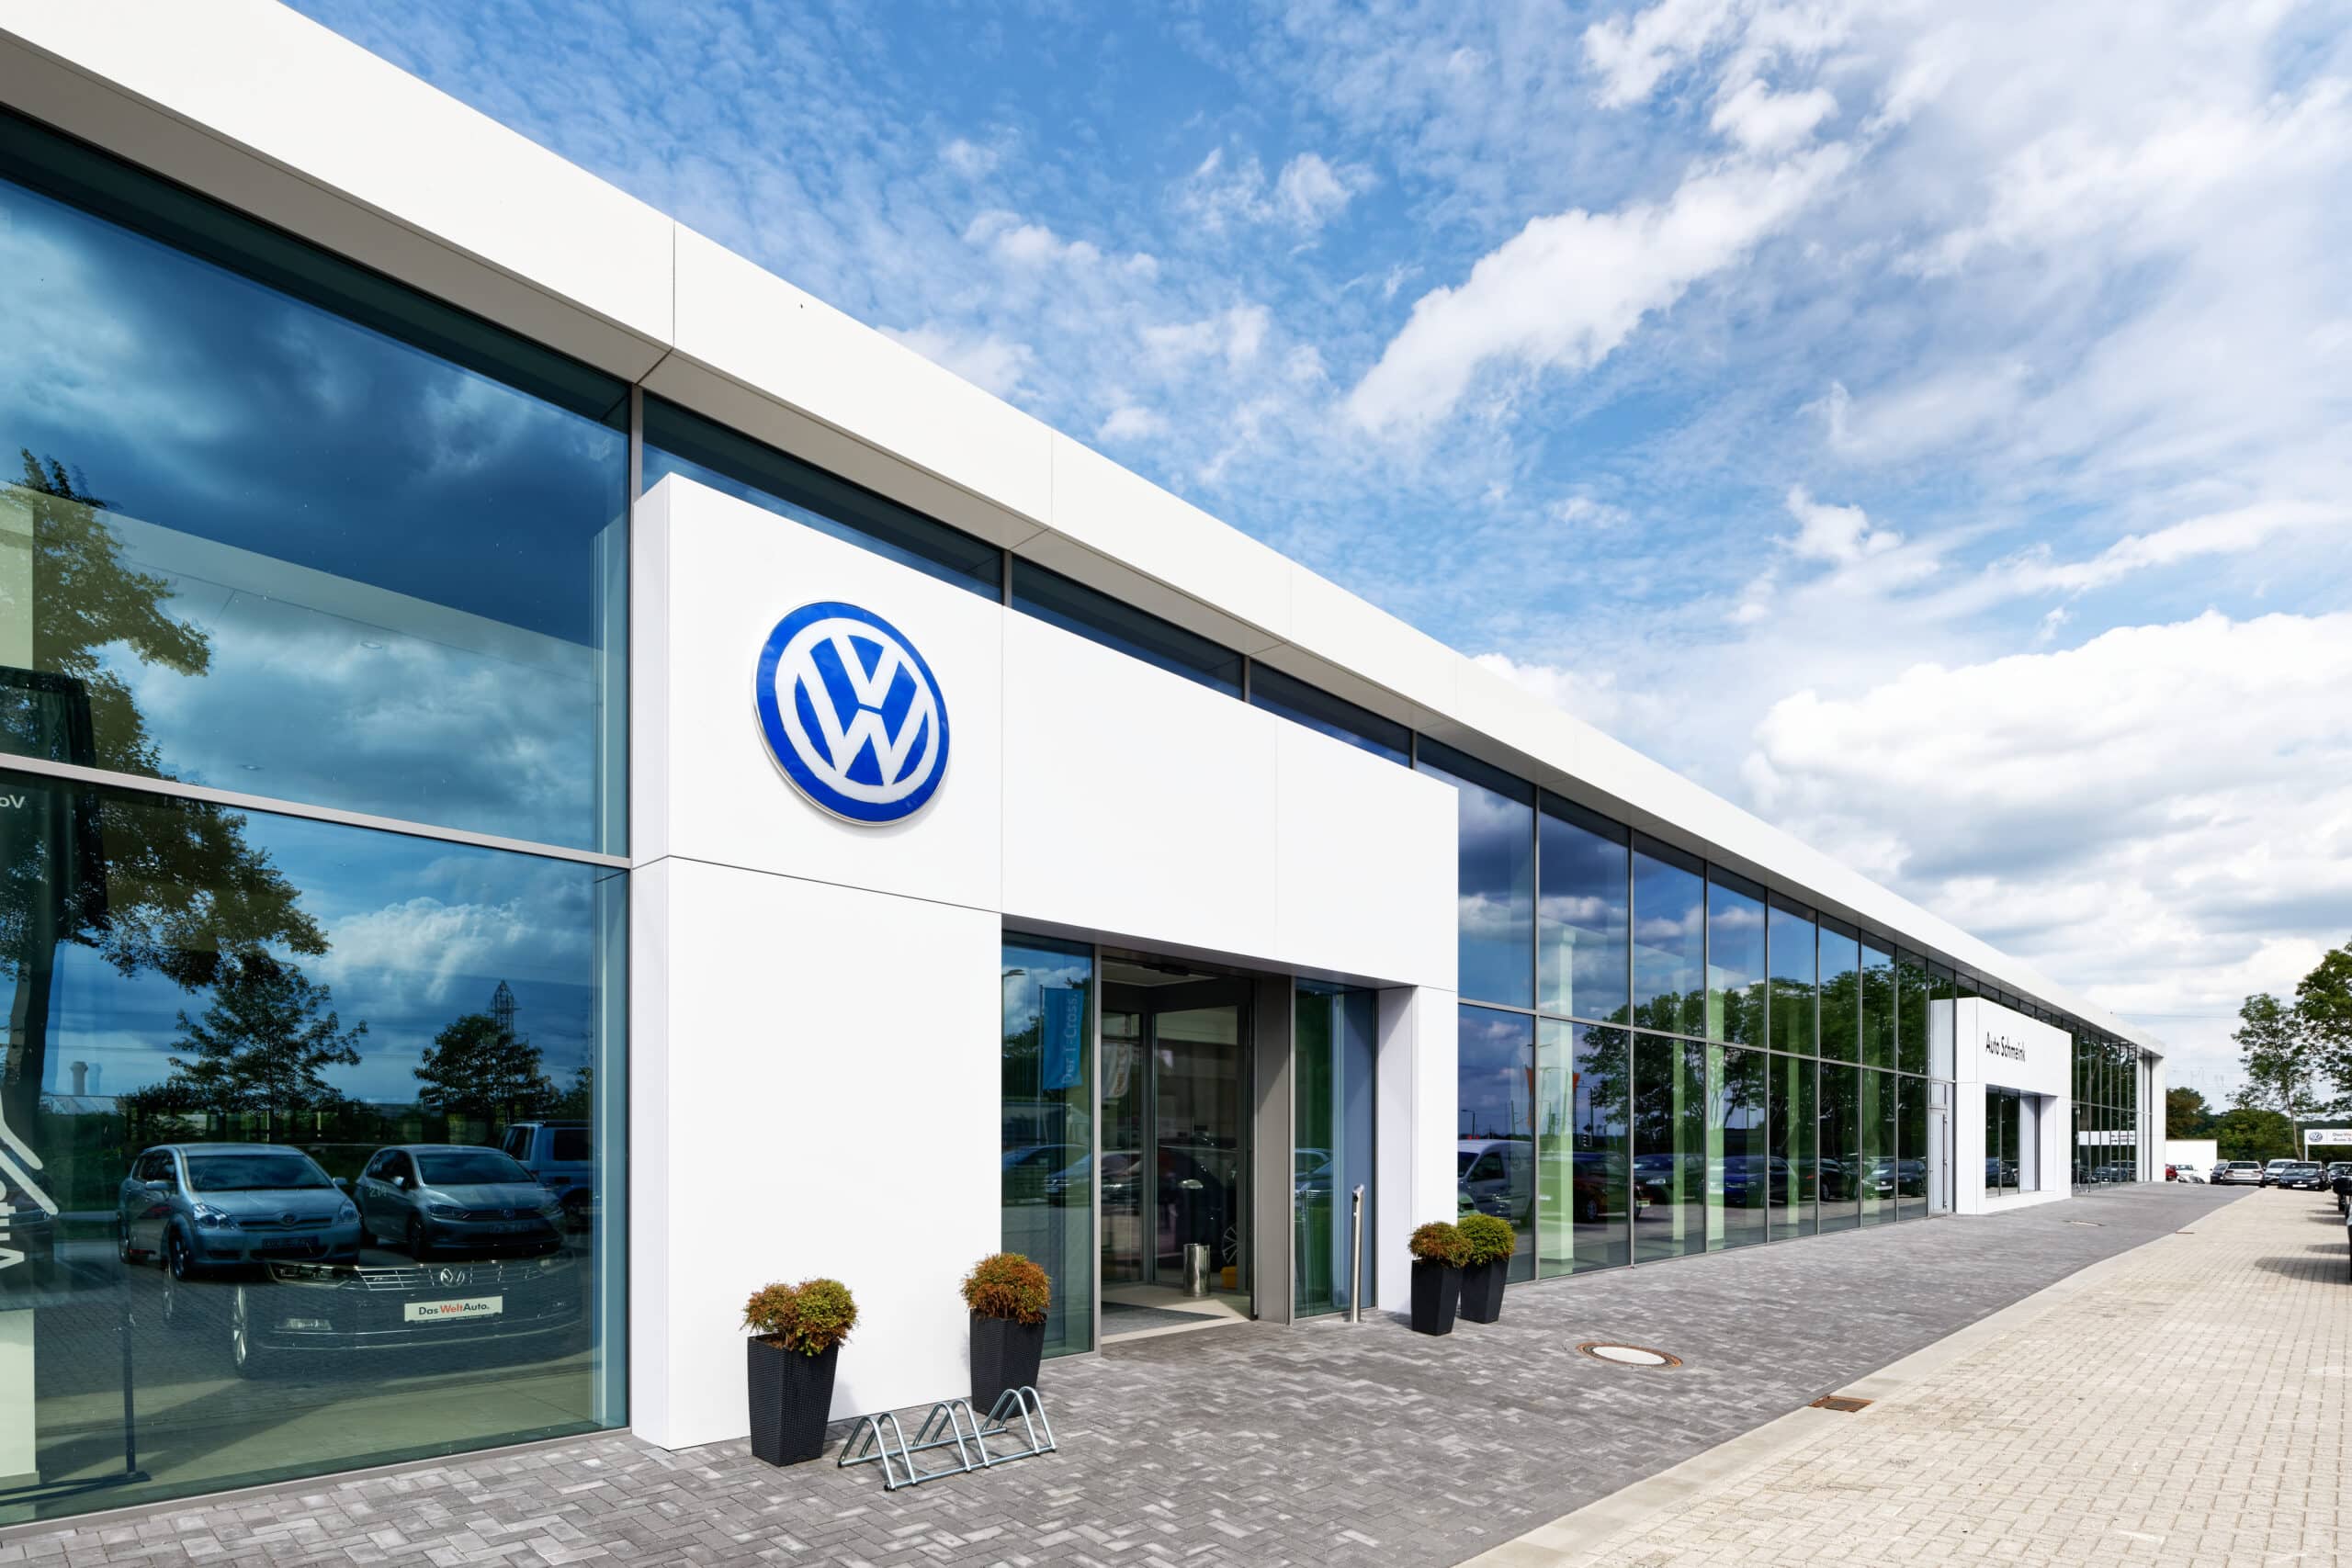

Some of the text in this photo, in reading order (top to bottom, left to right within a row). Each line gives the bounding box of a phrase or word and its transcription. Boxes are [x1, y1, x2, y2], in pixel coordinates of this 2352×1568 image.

[775, 617, 941, 805] VW
[1985, 1031, 1999, 1055] Auto
[1061, 1058, 1074, 1084] Der
[418, 1306, 438, 1315] Das
